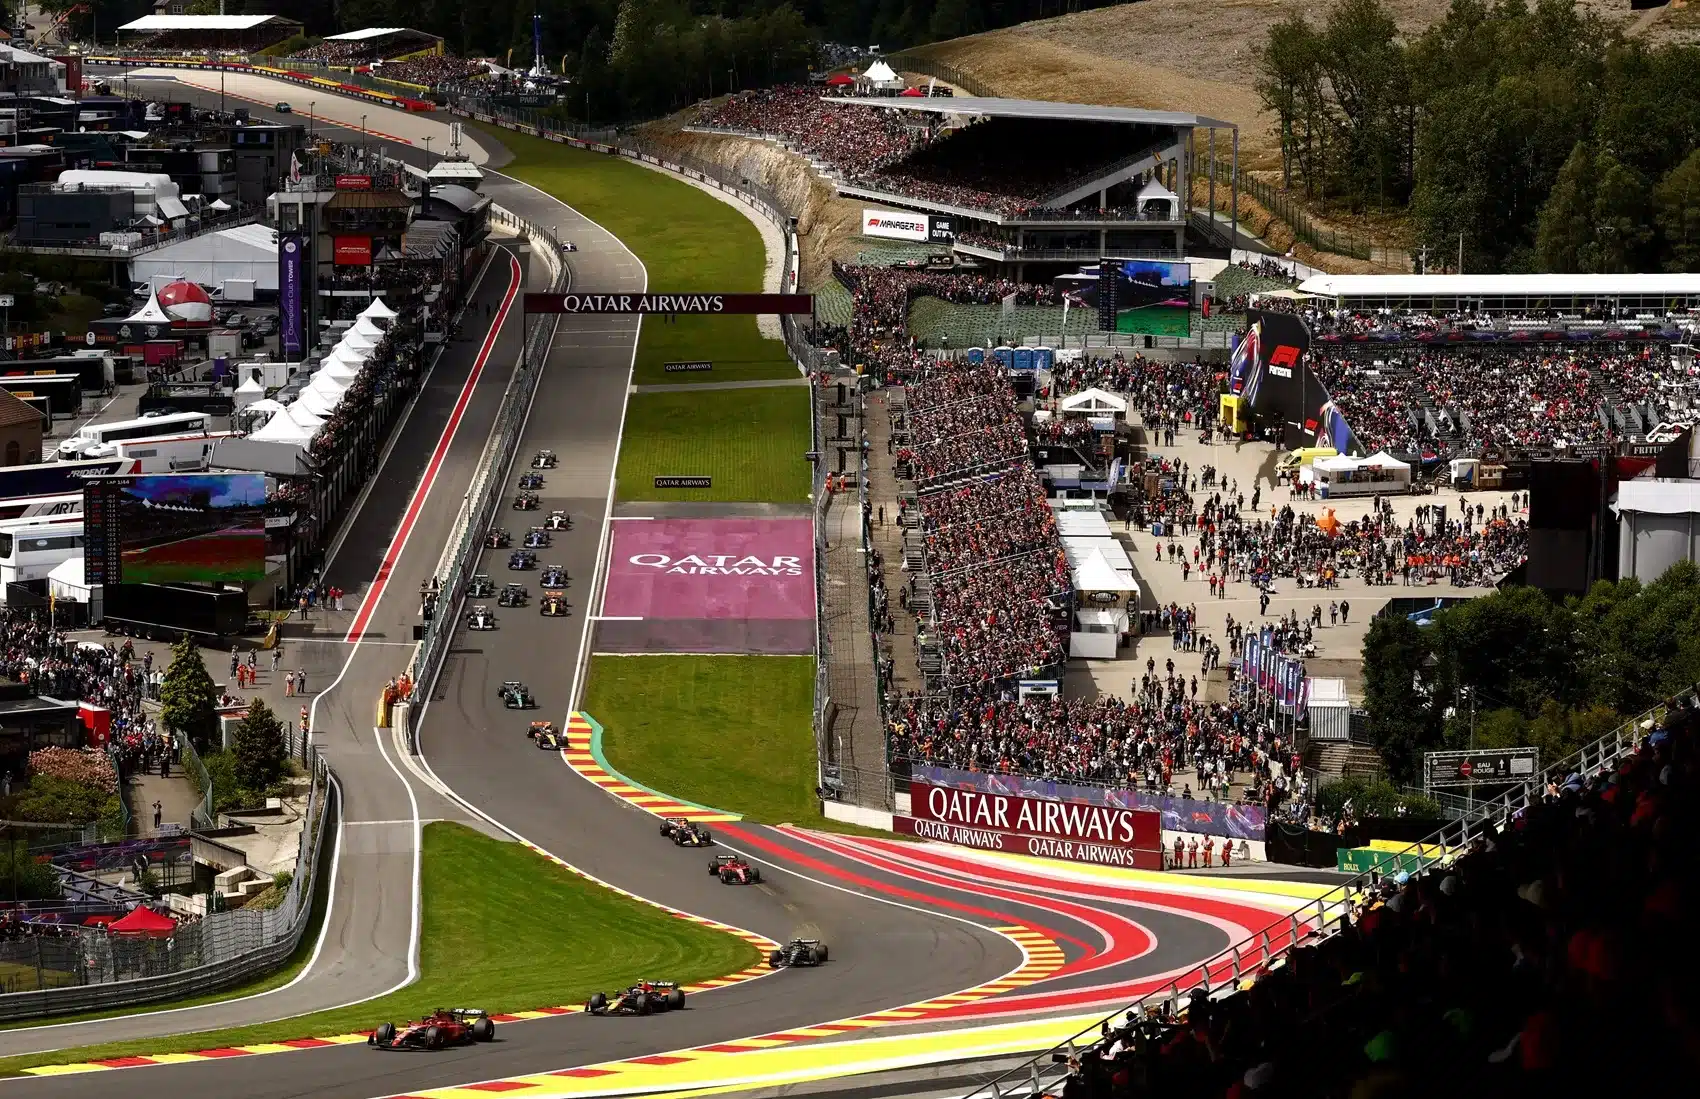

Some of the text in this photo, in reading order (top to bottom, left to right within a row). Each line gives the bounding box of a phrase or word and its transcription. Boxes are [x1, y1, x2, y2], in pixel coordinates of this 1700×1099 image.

[519, 96, 539, 104] PMR
[880, 220, 915, 231] MANAGER
[915, 223, 925, 232] 23
[935, 221, 950, 230] GAME
[932, 229, 941, 238] OUT
[563, 295, 724, 312] QATAR AIRWAYS
[1633, 445, 1666, 456] FRITU
[66, 467, 110, 479] TRIDENT
[656, 479, 680, 487] QATAR
[46, 501, 79, 516] ART
[629, 553, 803, 568] QATAR
[665, 567, 803, 577] AIRWAYS
[1473, 767, 1495, 775] ROUGE
[928, 787, 1135, 843] QATAR AIRWAYS
[914, 819, 1003, 850] QATAR AIRWAYS
[1028, 837, 1134, 866] QATAR AIRWAYS
[1343, 863, 1360, 872] ROLEX
